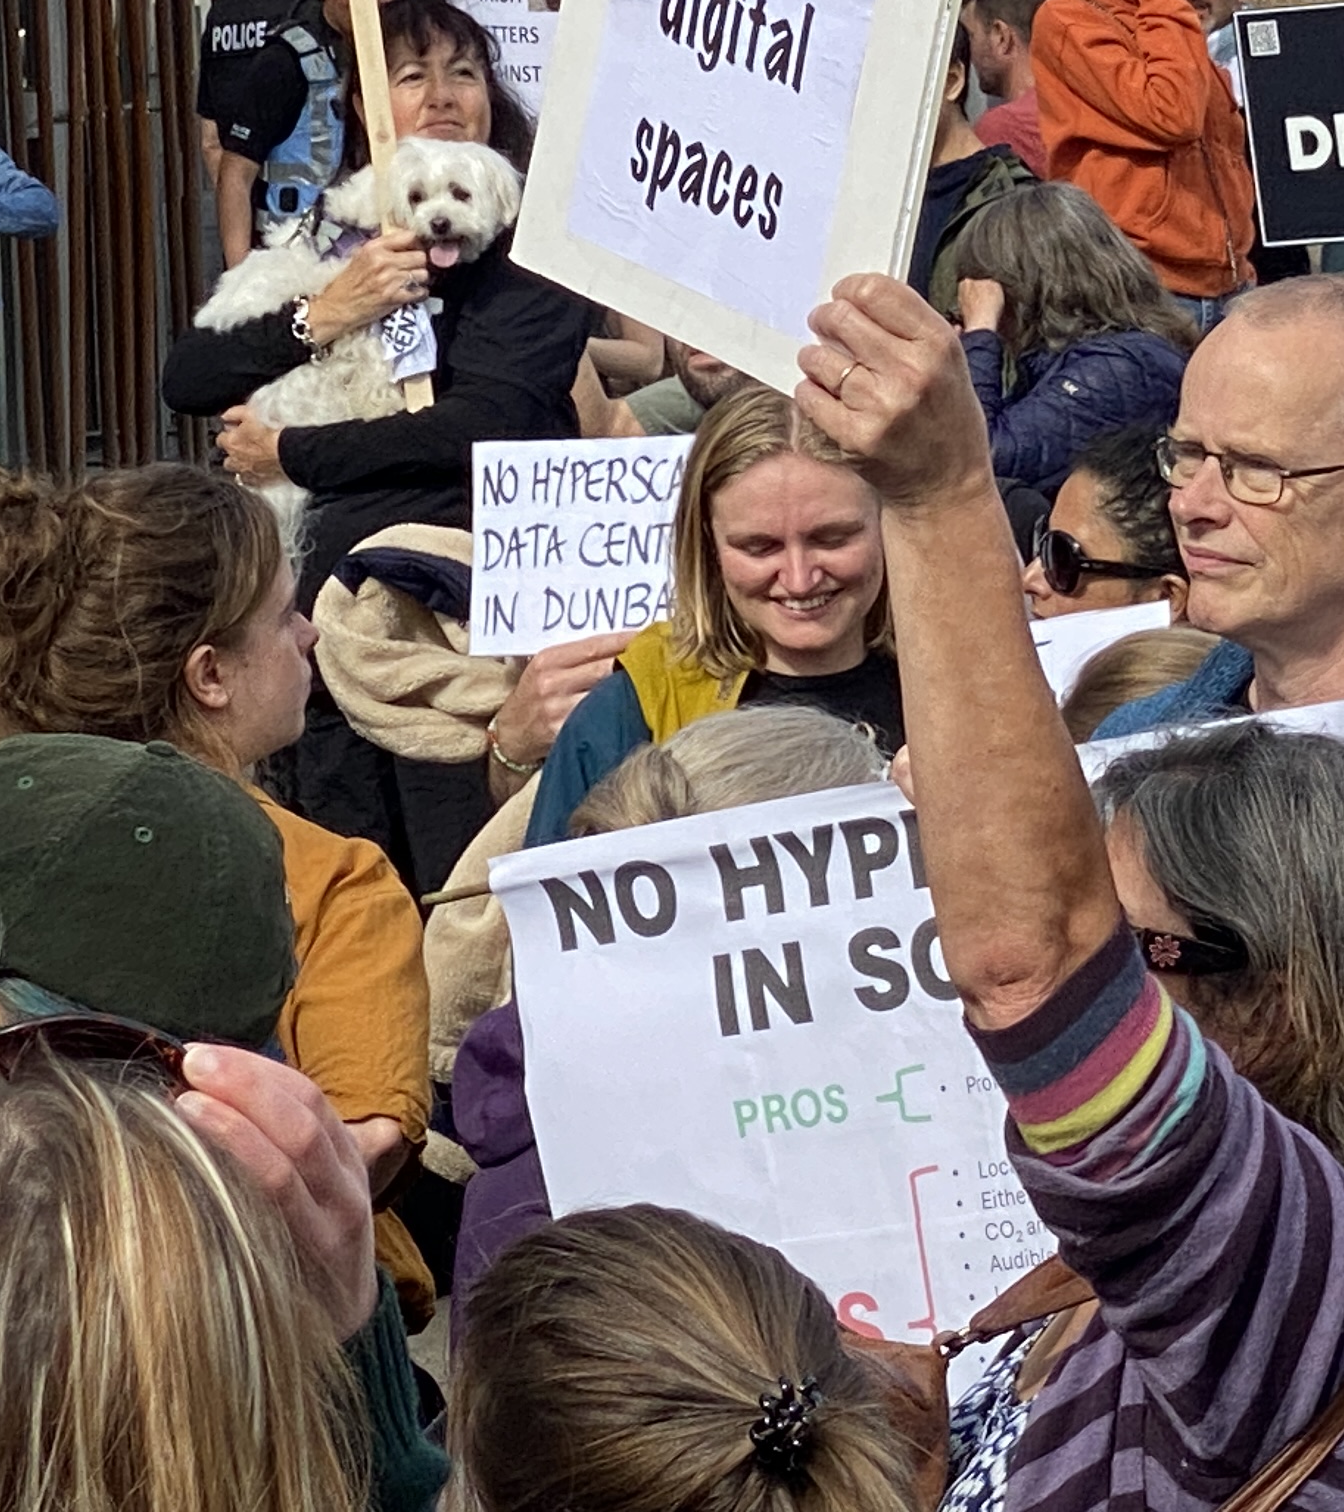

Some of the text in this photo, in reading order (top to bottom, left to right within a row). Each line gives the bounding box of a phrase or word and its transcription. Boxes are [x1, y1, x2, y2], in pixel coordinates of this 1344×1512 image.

[212, 20, 268, 52] POLICE
[630, 116, 783, 240] spaces
[482, 459, 519, 506] NO
[482, 521, 674, 572] DATA CENT
[484, 591, 519, 637] IN
[540, 860, 678, 952] NO
[712, 940, 814, 1037] IN
[966, 1075, 997, 1094] Pro
[732, 1083, 849, 1138] PROS
[978, 1160, 1013, 1179] Loc
